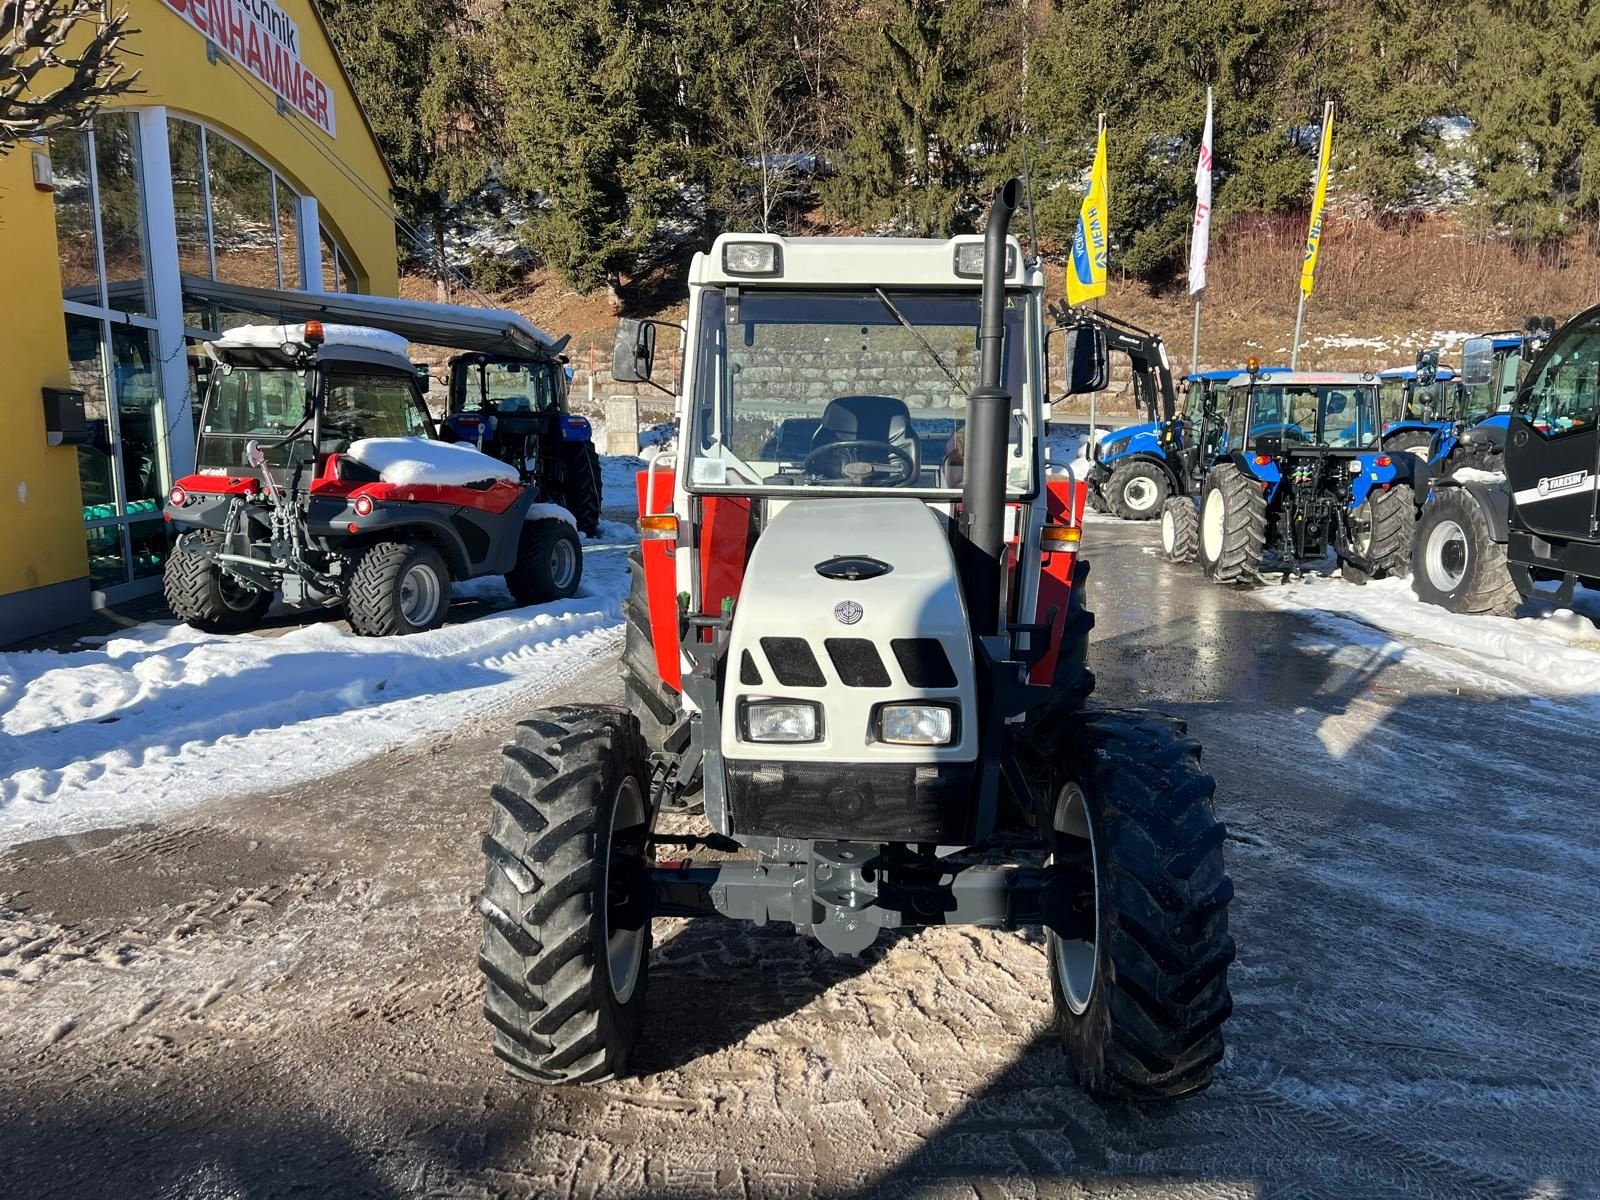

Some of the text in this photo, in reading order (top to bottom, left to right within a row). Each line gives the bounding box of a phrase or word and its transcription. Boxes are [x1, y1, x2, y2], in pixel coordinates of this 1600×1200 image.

[238, 0, 297, 54] chnik
[166, 0, 329, 131] ENHAMMER
[1549, 474, 1582, 490] FARESIN
